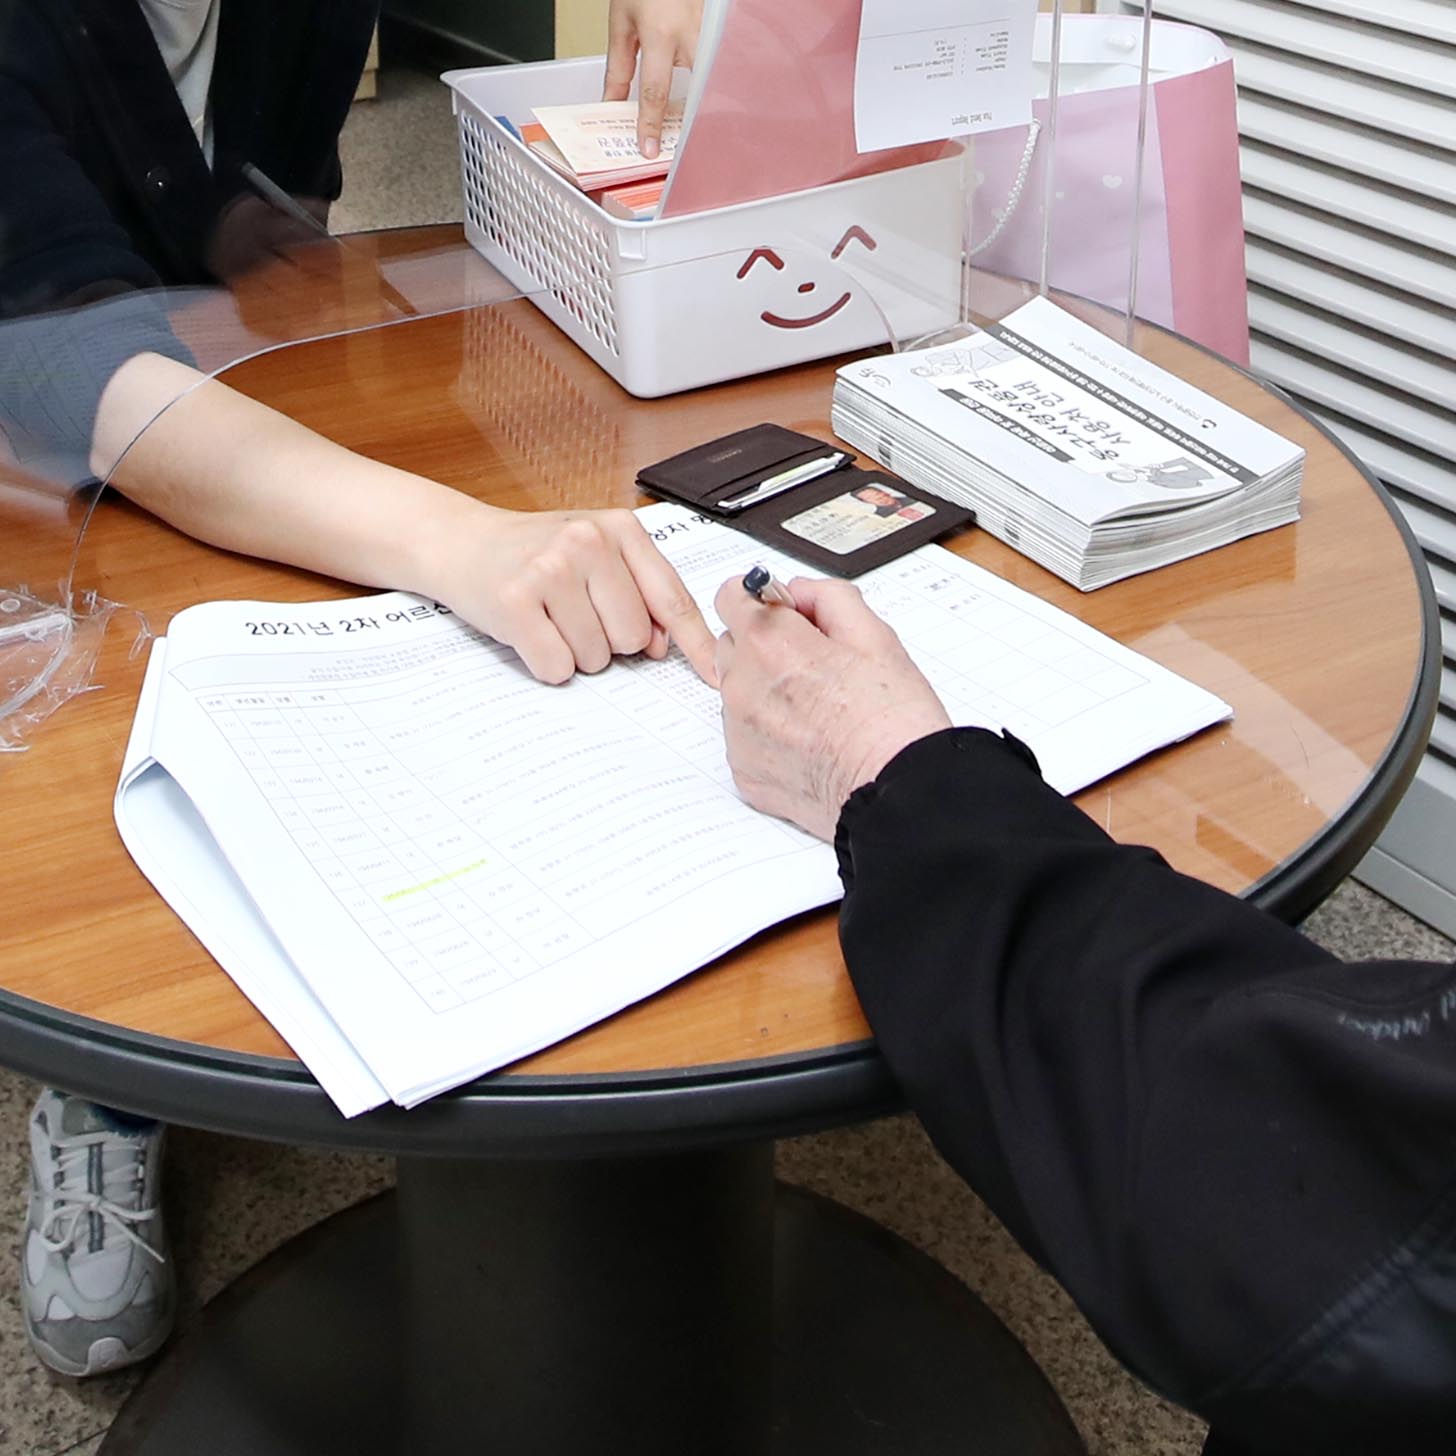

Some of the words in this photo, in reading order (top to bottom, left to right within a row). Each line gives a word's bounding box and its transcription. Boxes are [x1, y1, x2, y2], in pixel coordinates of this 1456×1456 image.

[1013, 380, 1065, 408] 안내
[967, 379, 1120, 461] 동구사랑상품권
[1058, 407, 1132, 444] 사용처
[245, 621, 334, 636] 2021년
[339, 616, 381, 633] 2차
